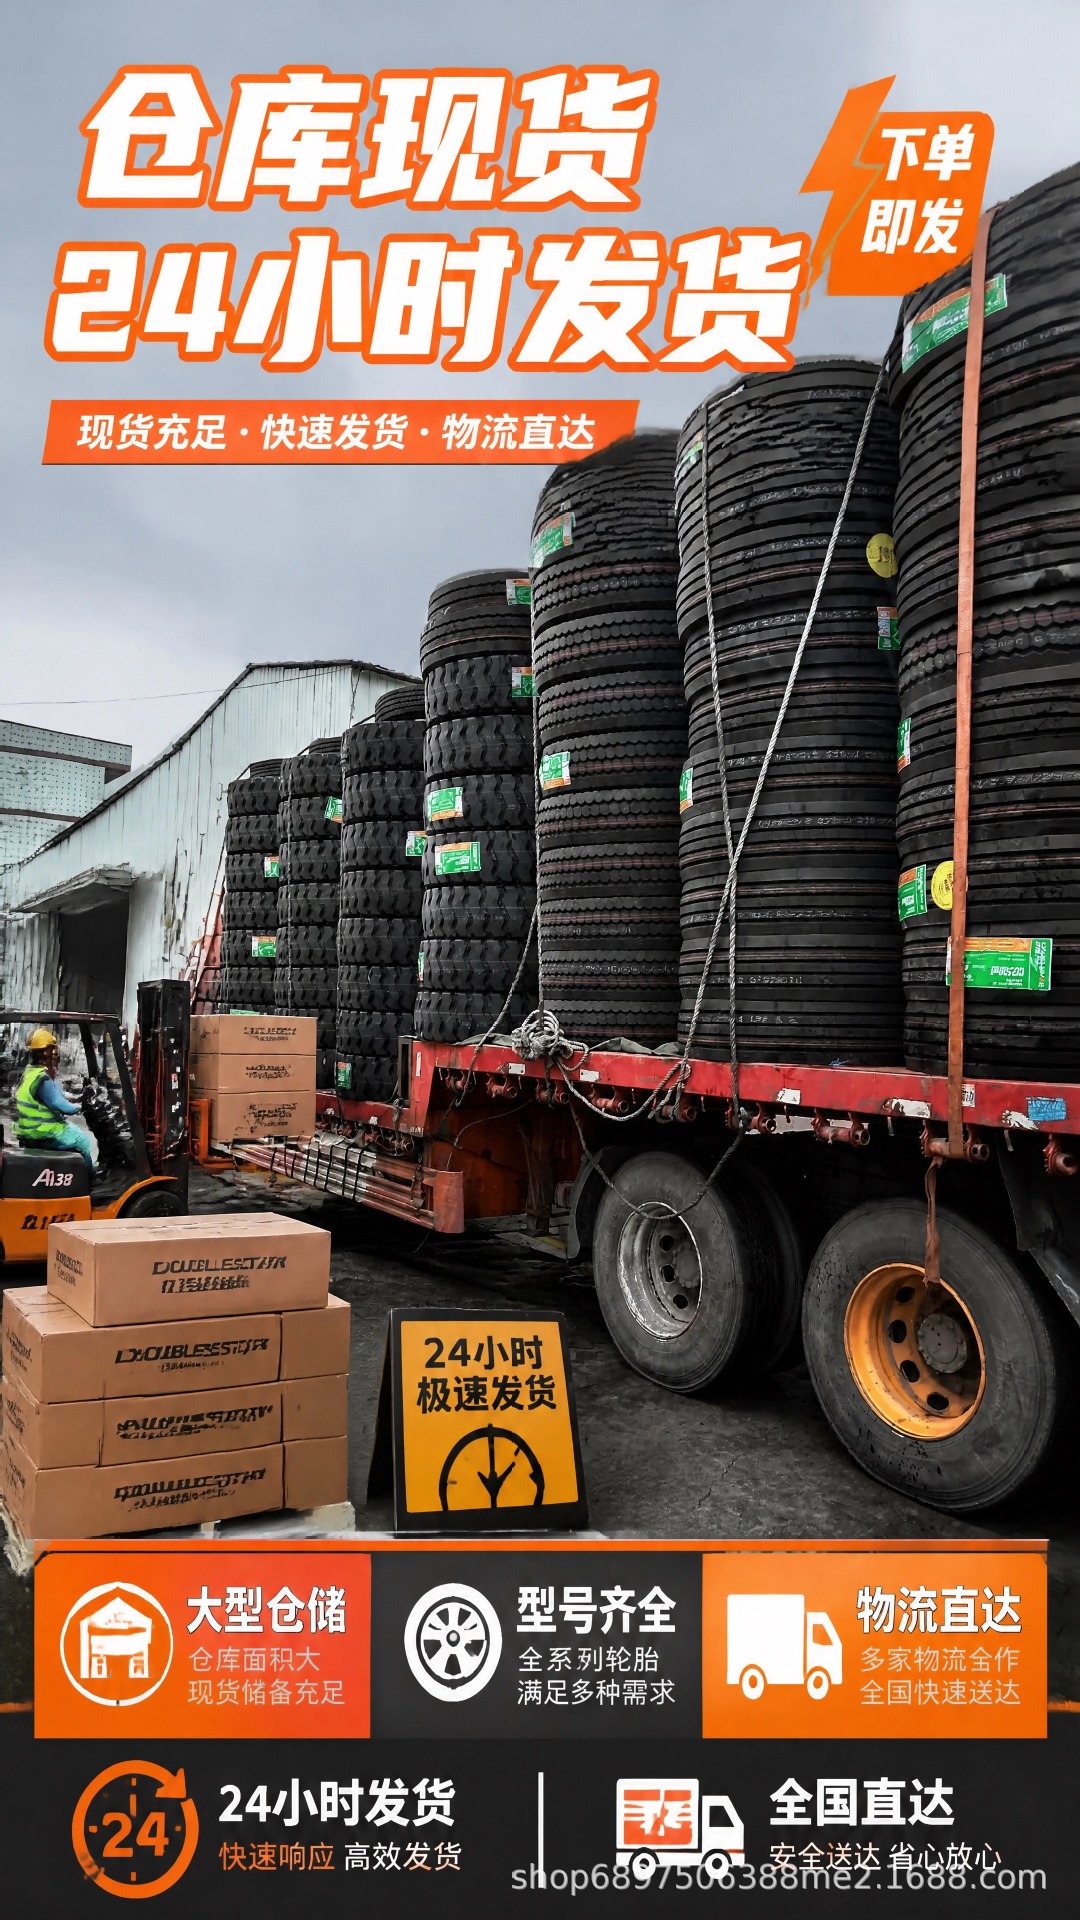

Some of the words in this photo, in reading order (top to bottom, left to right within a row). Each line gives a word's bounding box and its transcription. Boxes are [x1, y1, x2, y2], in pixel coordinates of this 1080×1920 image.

[424, 1335, 543, 1370] 24小时
[416, 1374, 557, 1414] 极速发货
